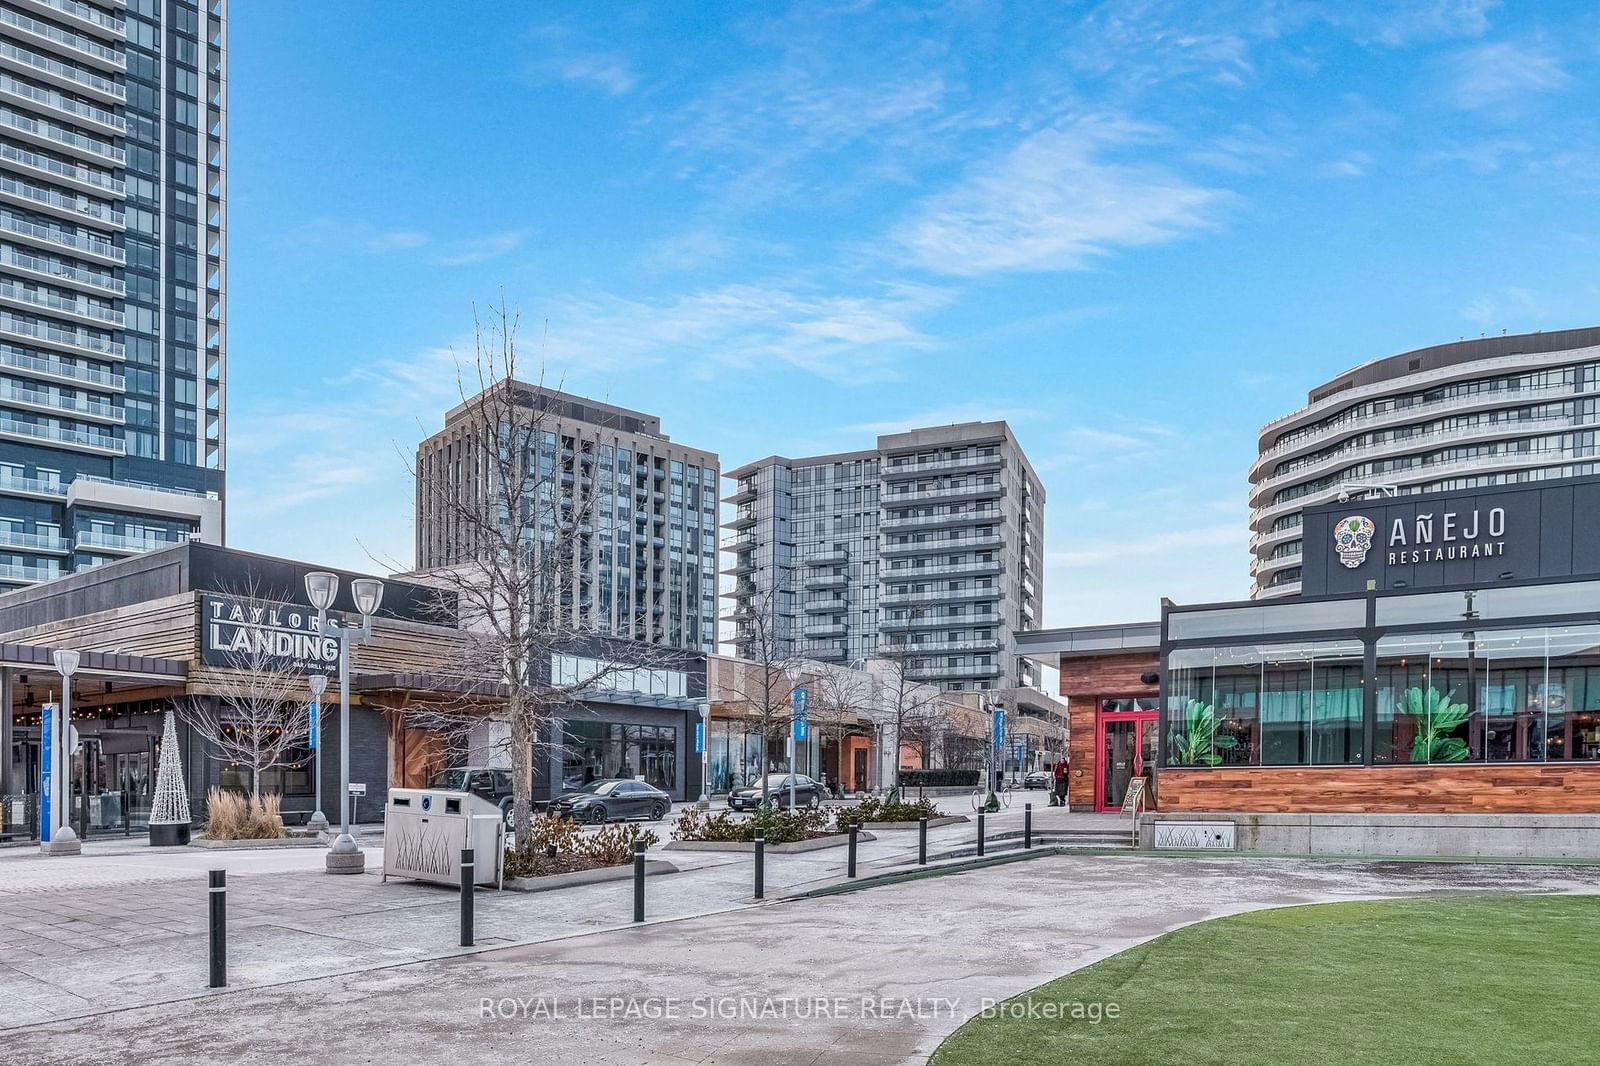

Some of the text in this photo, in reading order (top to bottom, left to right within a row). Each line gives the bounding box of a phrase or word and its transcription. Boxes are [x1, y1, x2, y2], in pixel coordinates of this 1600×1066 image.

[1389, 507, 1505, 547] AÑEJO
[1388, 541, 1505, 565] RESTAURANT
[210, 600, 339, 633] TAYLORS
[209, 623, 339, 662] LANDING
